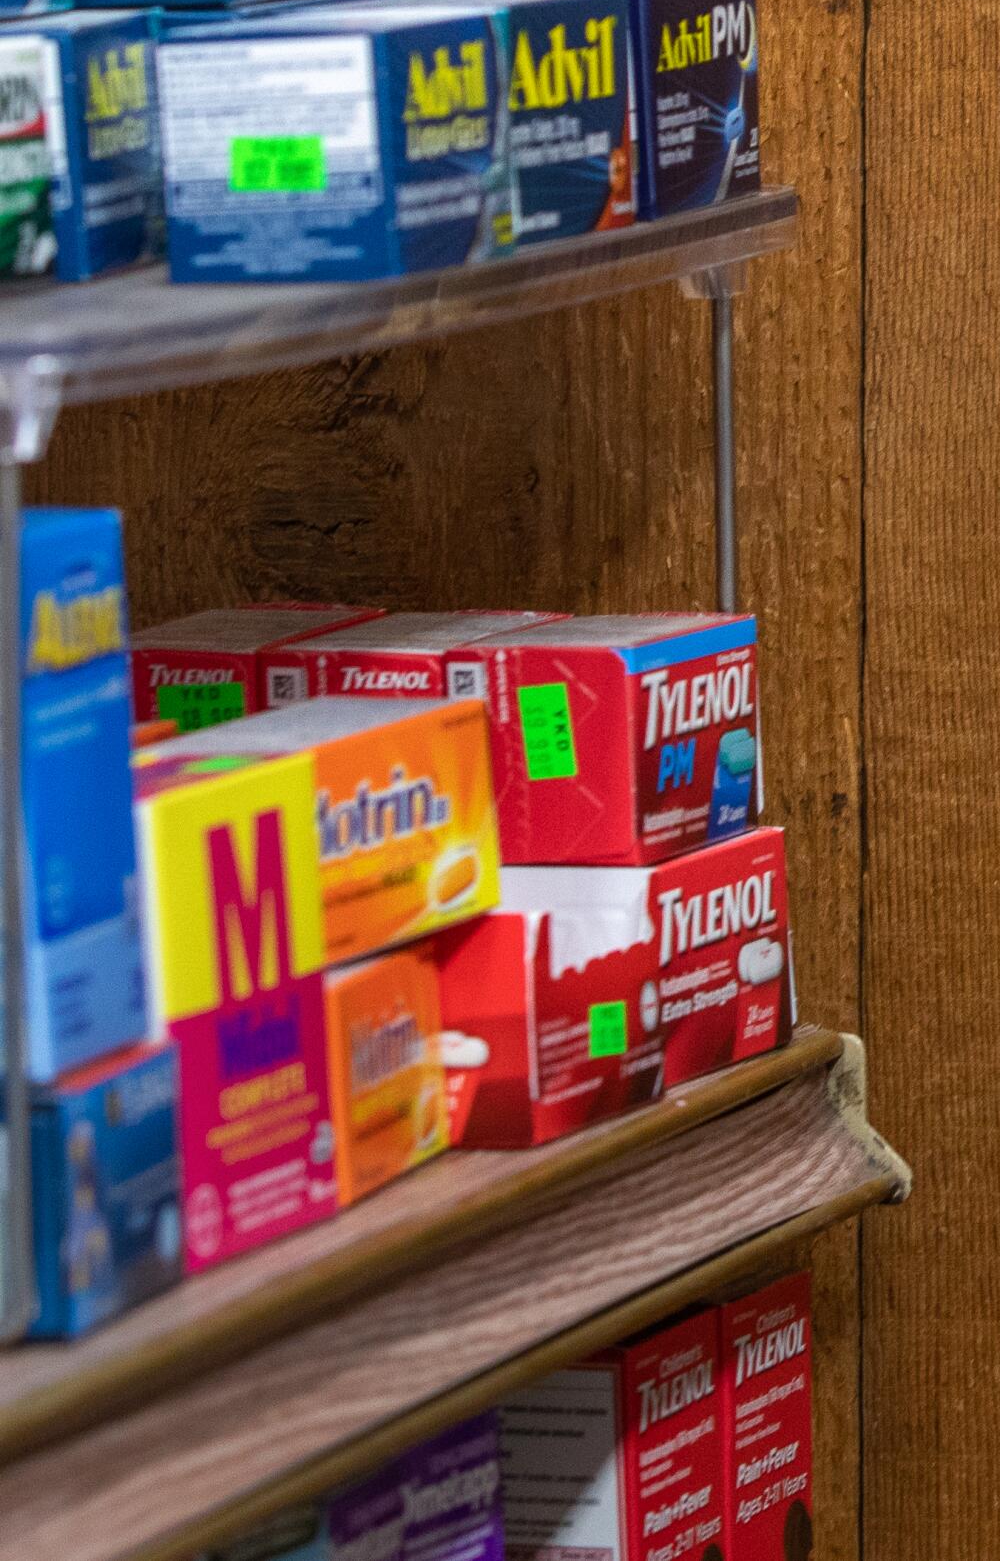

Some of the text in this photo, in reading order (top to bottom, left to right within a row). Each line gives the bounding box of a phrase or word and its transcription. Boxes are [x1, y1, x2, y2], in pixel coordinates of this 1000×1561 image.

[404, 41, 487, 121] Advil
[507, 14, 617, 111] Advil
[340, 667, 431, 690] TYLENOL
[641, 662, 753, 751] TYLENOL
[657, 738, 696, 793] PM
[658, 870, 777, 968] TYLENOL
[733, 1318, 806, 1388] TYLENOL
[637, 1359, 714, 1434] TYLENOL
